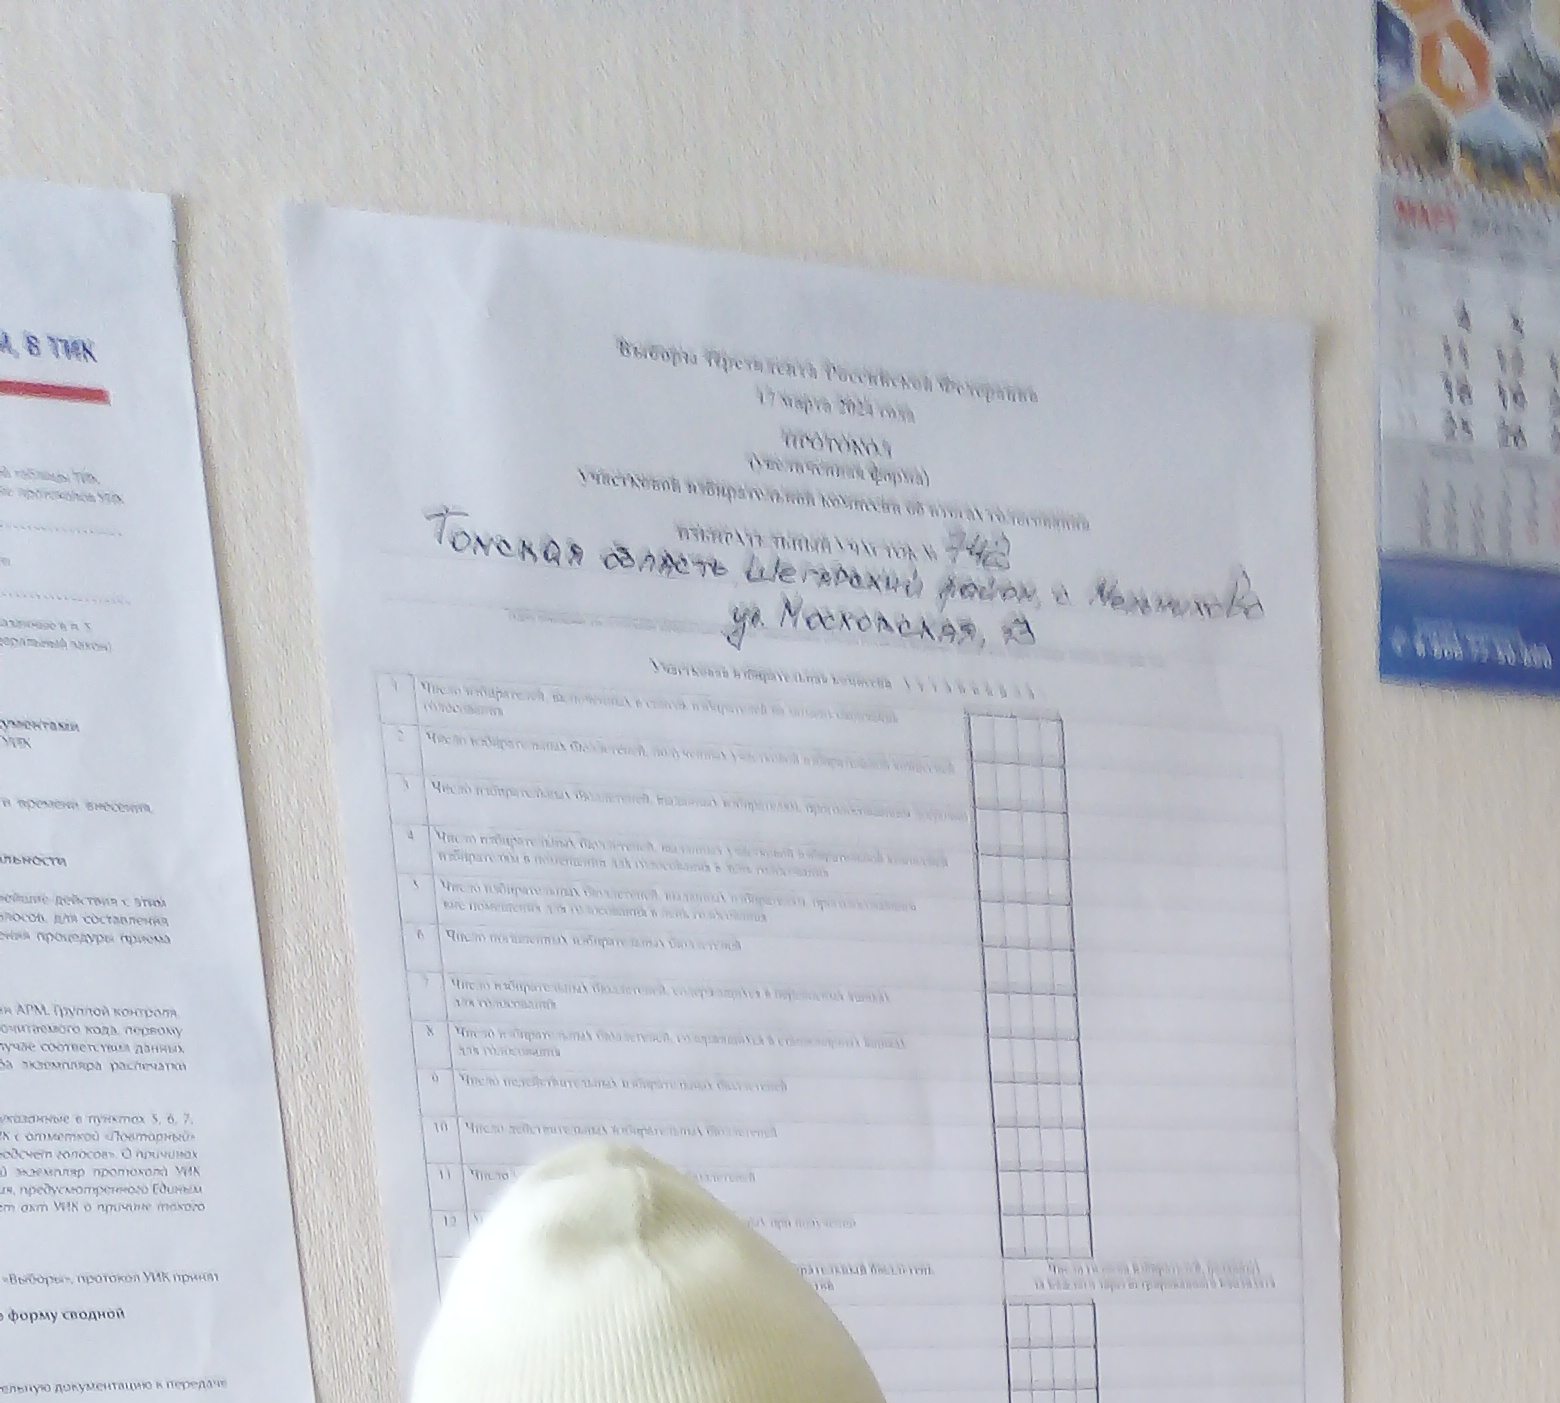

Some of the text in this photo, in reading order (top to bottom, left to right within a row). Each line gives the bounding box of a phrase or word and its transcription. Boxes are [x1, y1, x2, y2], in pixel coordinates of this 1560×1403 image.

[424, 505, 584, 566] Томская
[8, 1306, 126, 1324] форму сводной
[55, 1380, 152, 1394] документацию
